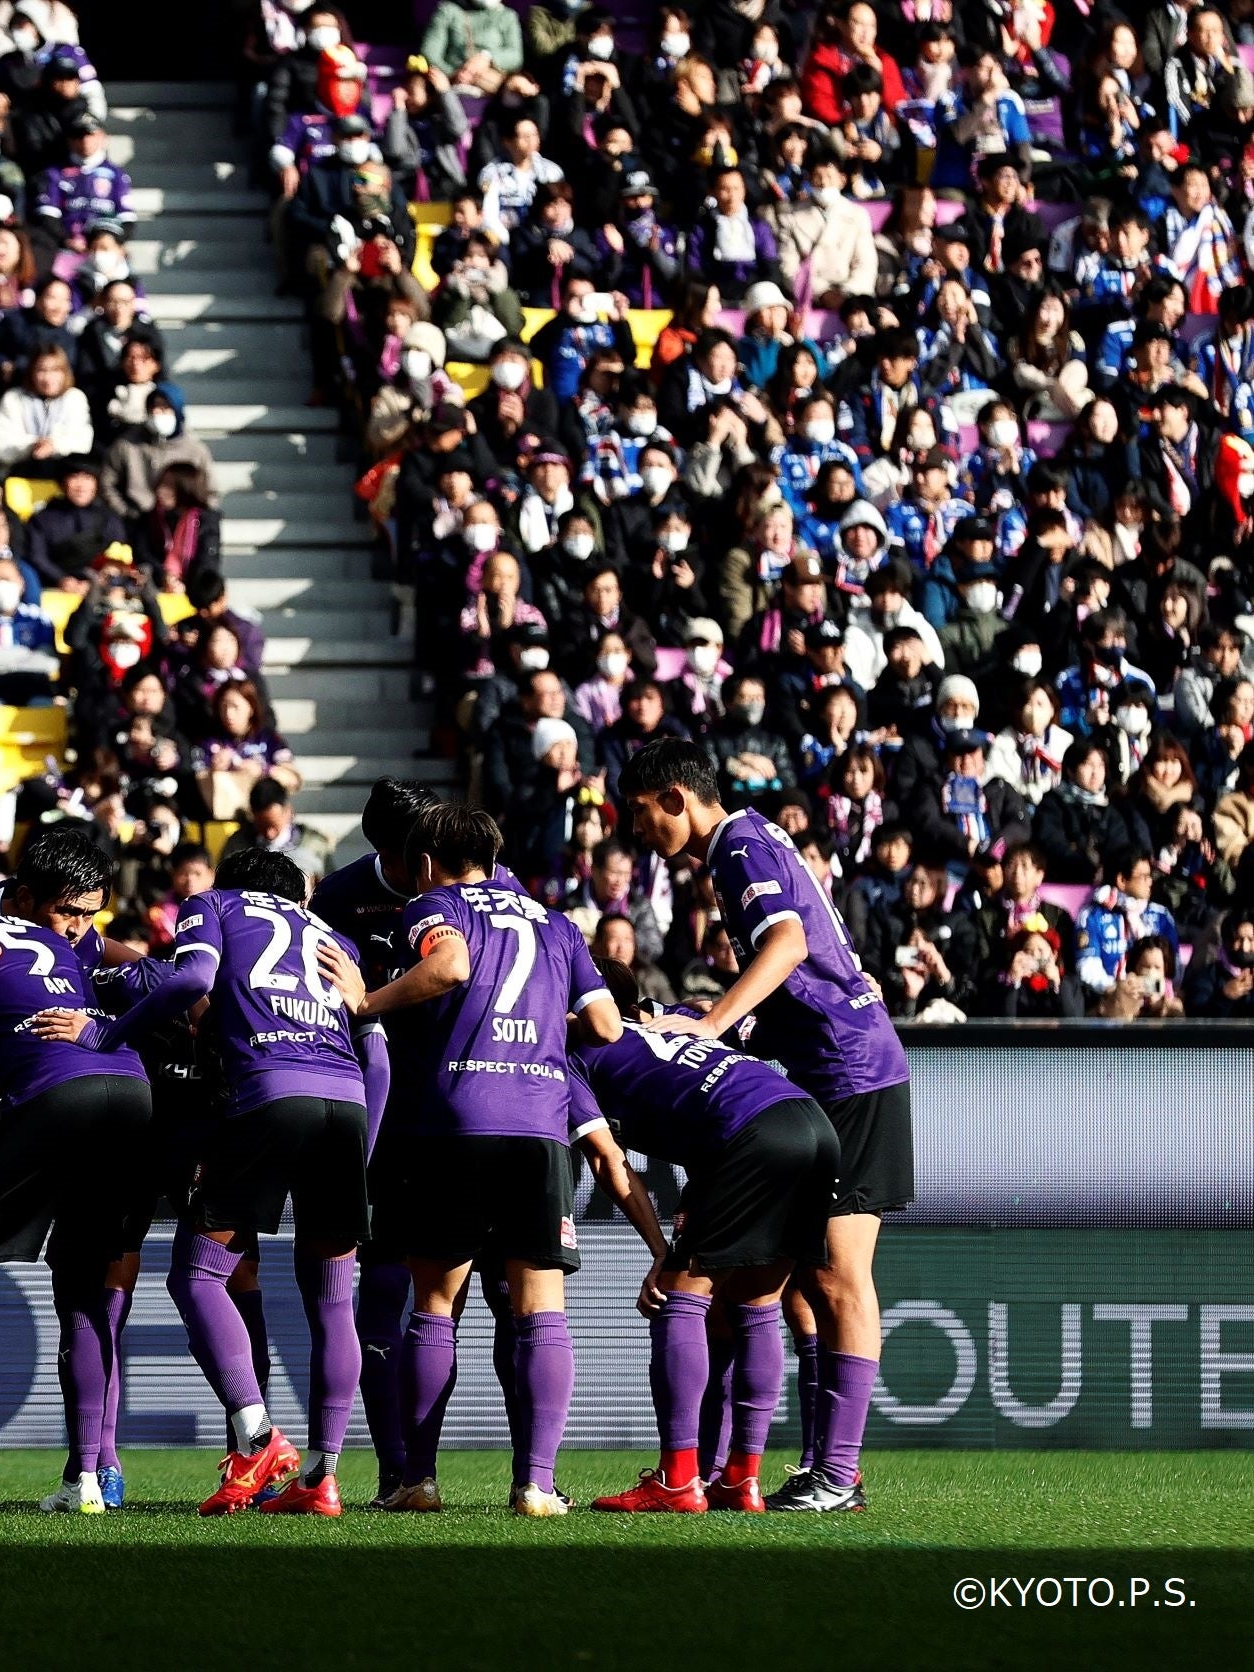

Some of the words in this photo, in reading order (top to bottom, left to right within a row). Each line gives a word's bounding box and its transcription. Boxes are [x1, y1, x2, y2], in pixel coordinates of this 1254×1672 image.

[489, 914, 536, 1014] 7
[43, 977, 77, 995] API
[249, 1030, 316, 1046] RESPECT
[492, 1017, 538, 1044] SOTA
[448, 1059, 517, 1073] RESPECT
[520, 1063, 553, 1079] YOU,
[773, 1299, 1254, 1430] OUTE
